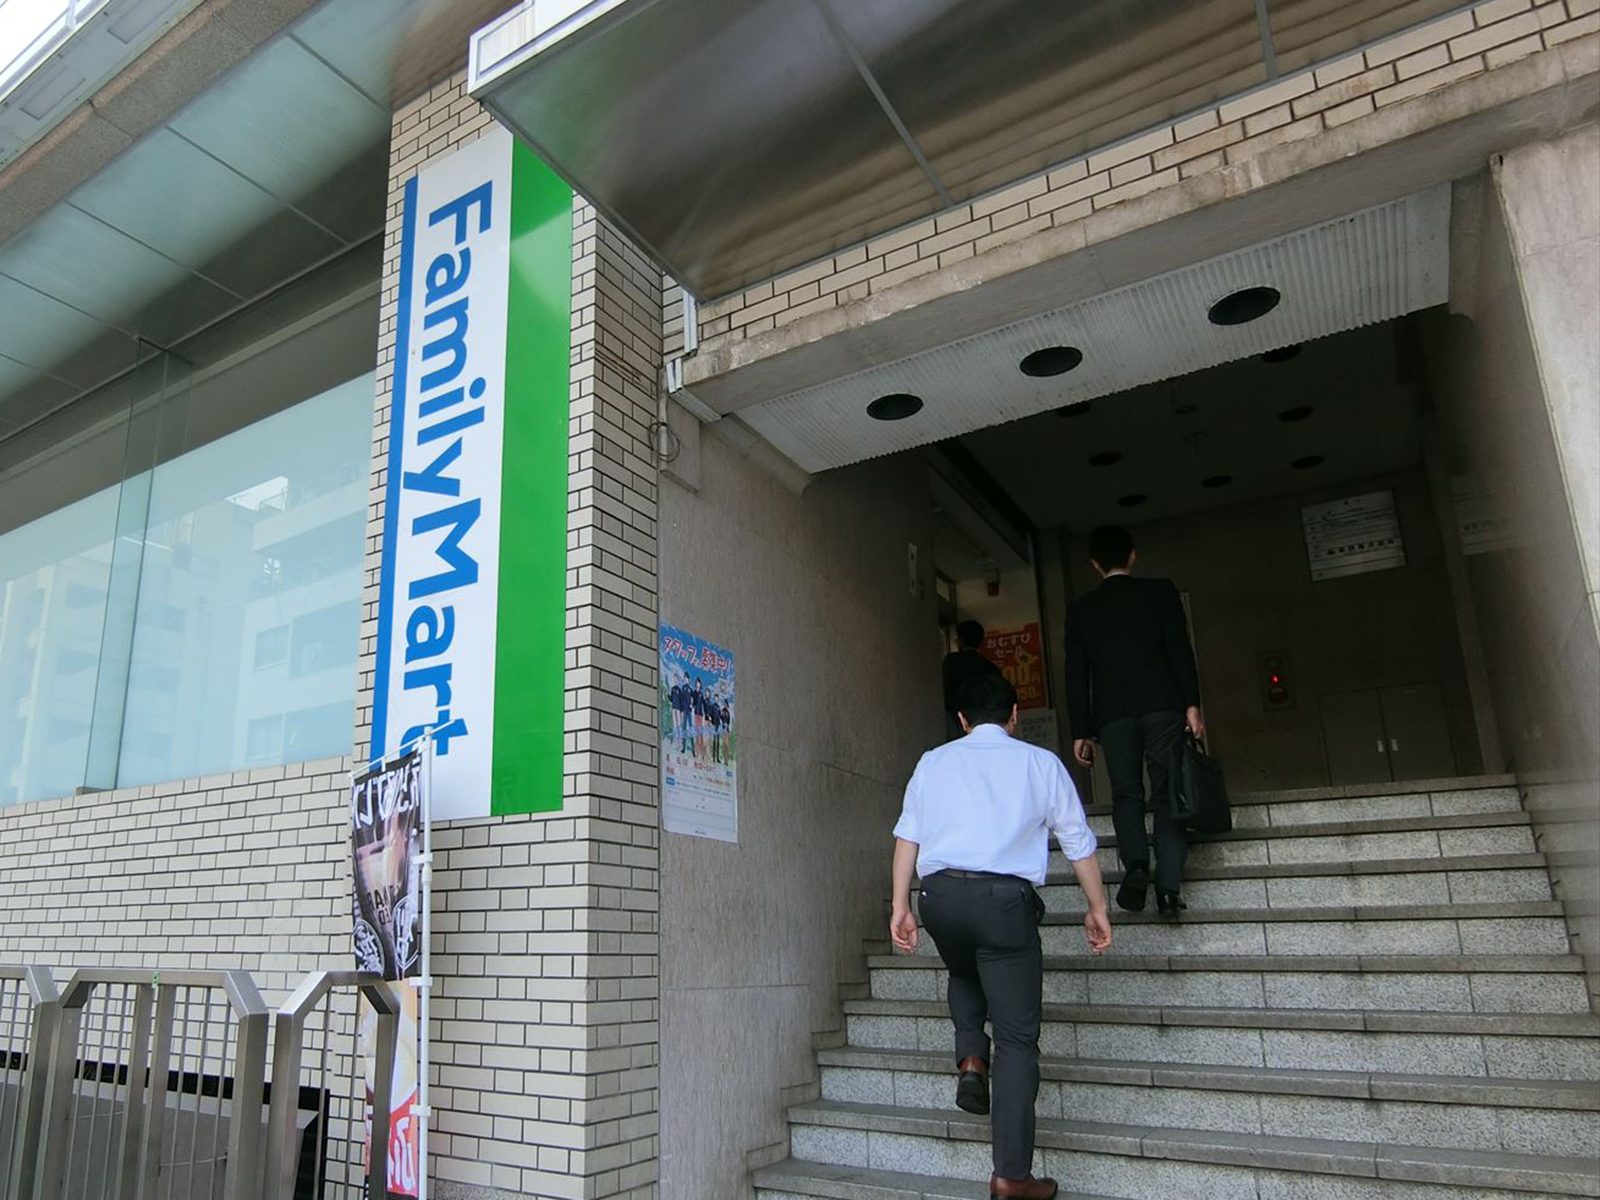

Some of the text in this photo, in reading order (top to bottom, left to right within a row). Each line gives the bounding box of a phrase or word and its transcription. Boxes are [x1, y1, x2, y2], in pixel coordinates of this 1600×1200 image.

[402, 179, 493, 757] FamilyMart
[986, 632, 1033, 649] おむすび
